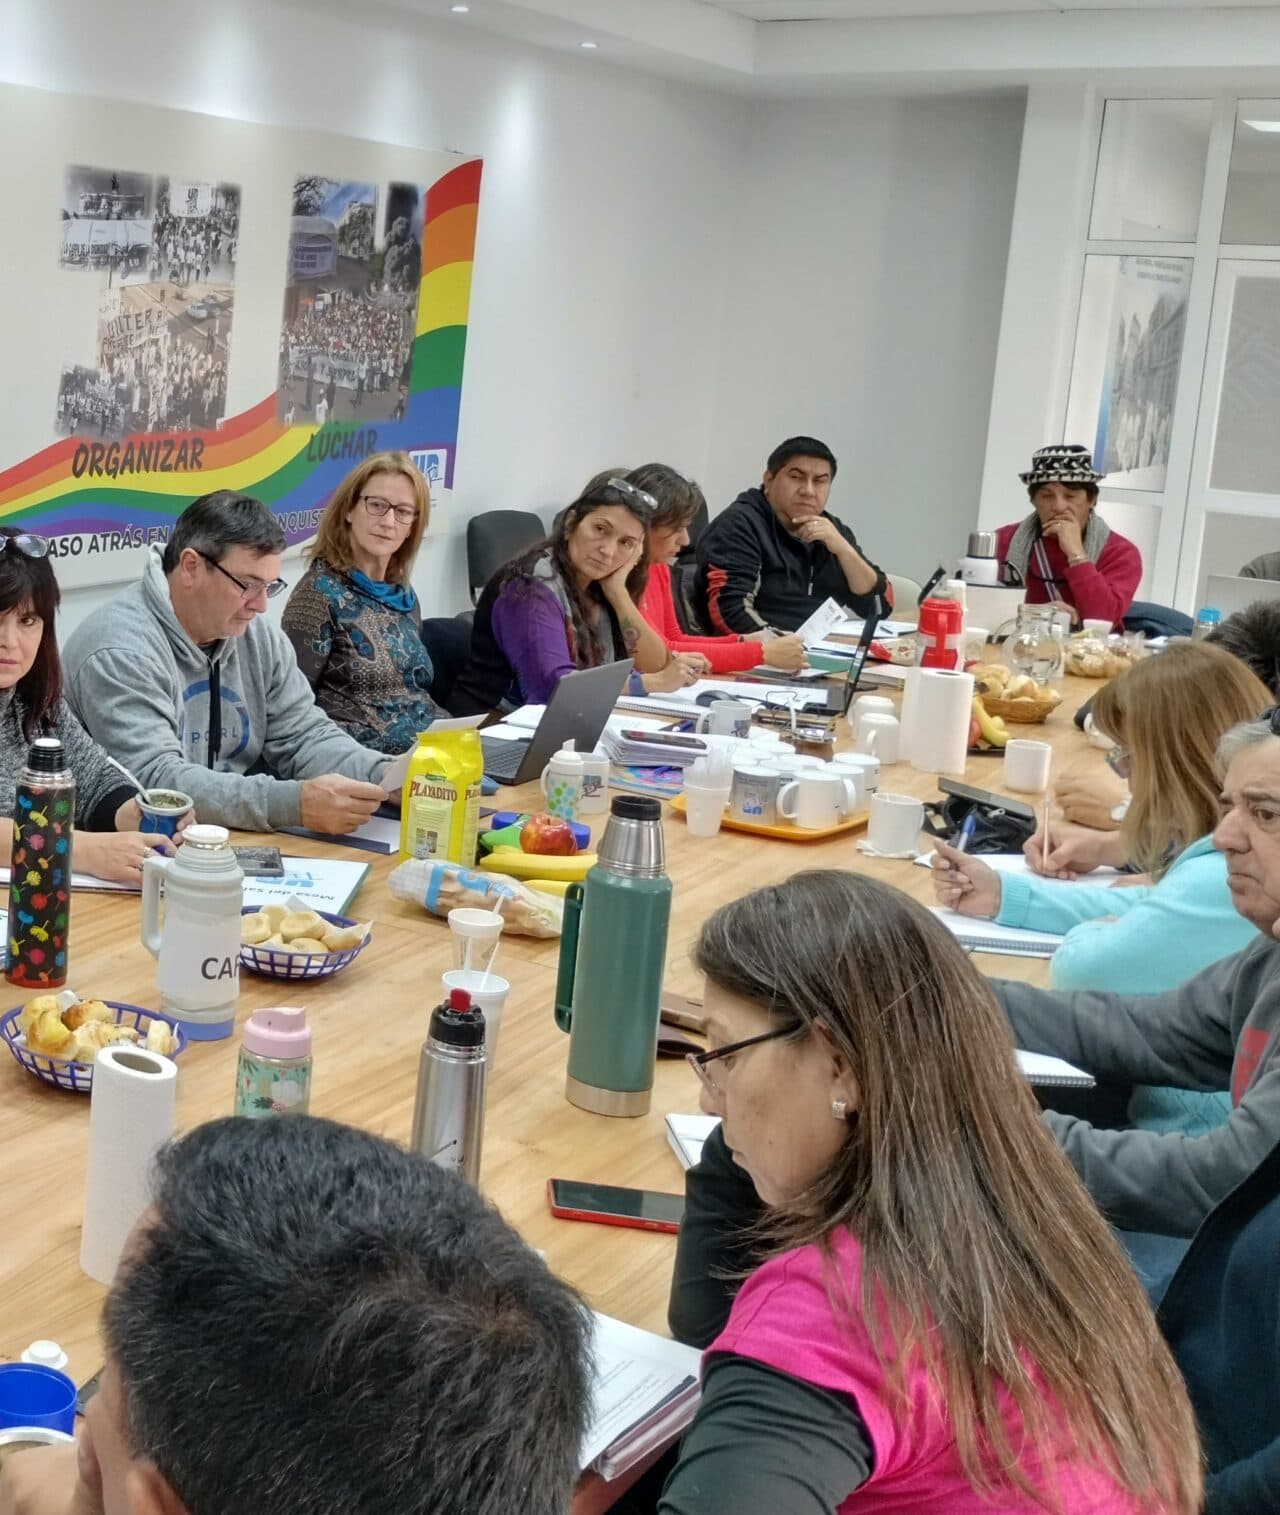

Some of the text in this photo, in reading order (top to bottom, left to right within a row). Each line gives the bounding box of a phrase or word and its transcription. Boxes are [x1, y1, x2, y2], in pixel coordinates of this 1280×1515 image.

[72, 437, 205, 480] ORGANIZAR
[306, 430, 378, 462] LUCHAR
[48, 536, 83, 558] ASO
[88, 522, 142, 553] ATRÁS
[409, 780, 458, 802] PLAYADITO
